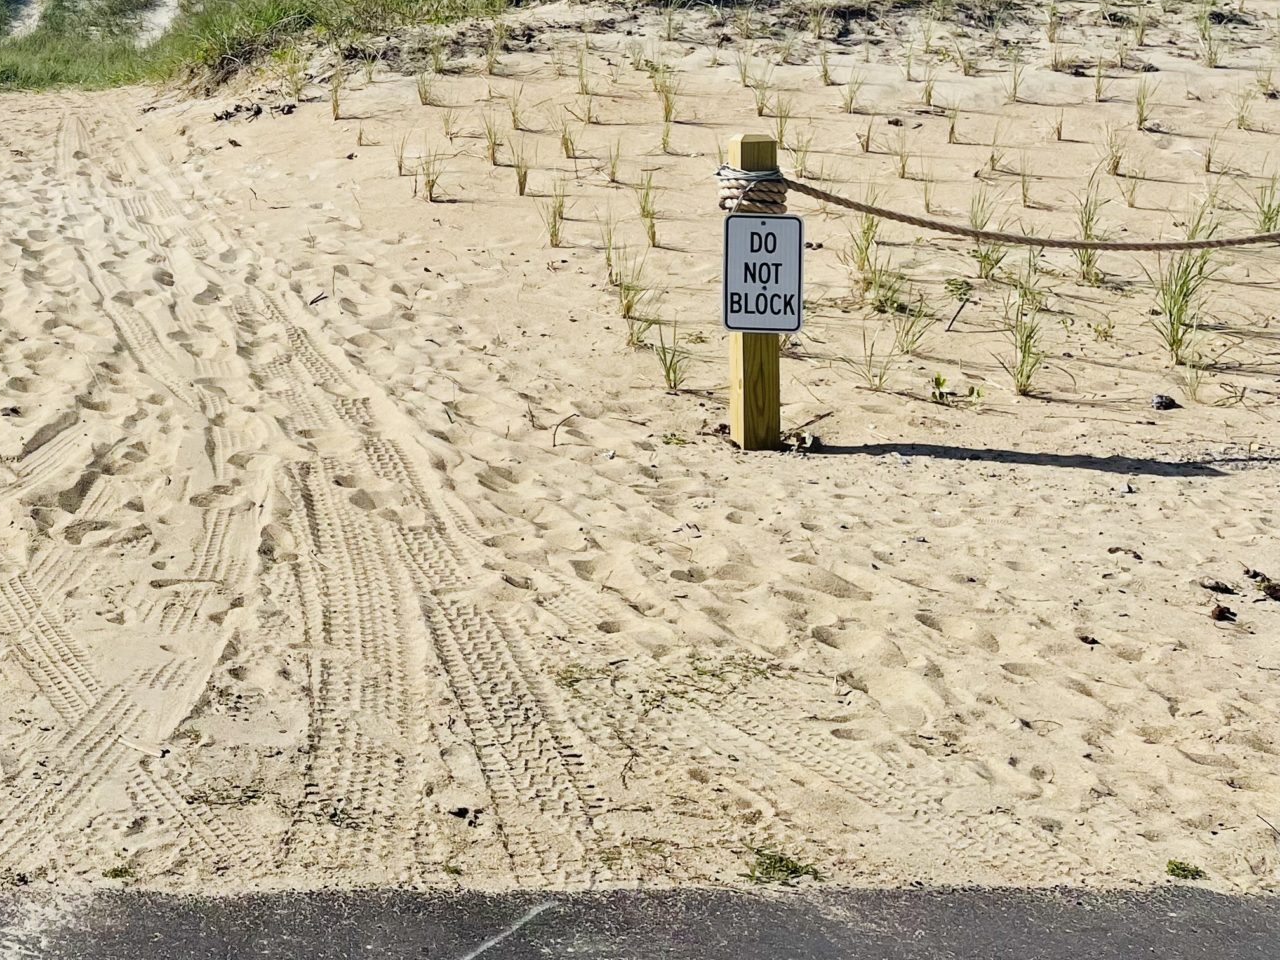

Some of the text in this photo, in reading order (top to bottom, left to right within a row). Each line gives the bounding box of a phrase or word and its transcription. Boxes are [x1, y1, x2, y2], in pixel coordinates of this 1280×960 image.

[750, 231, 777, 254] DO
[743, 262, 783, 284] NOT
[730, 292, 796, 315] BLOCK
